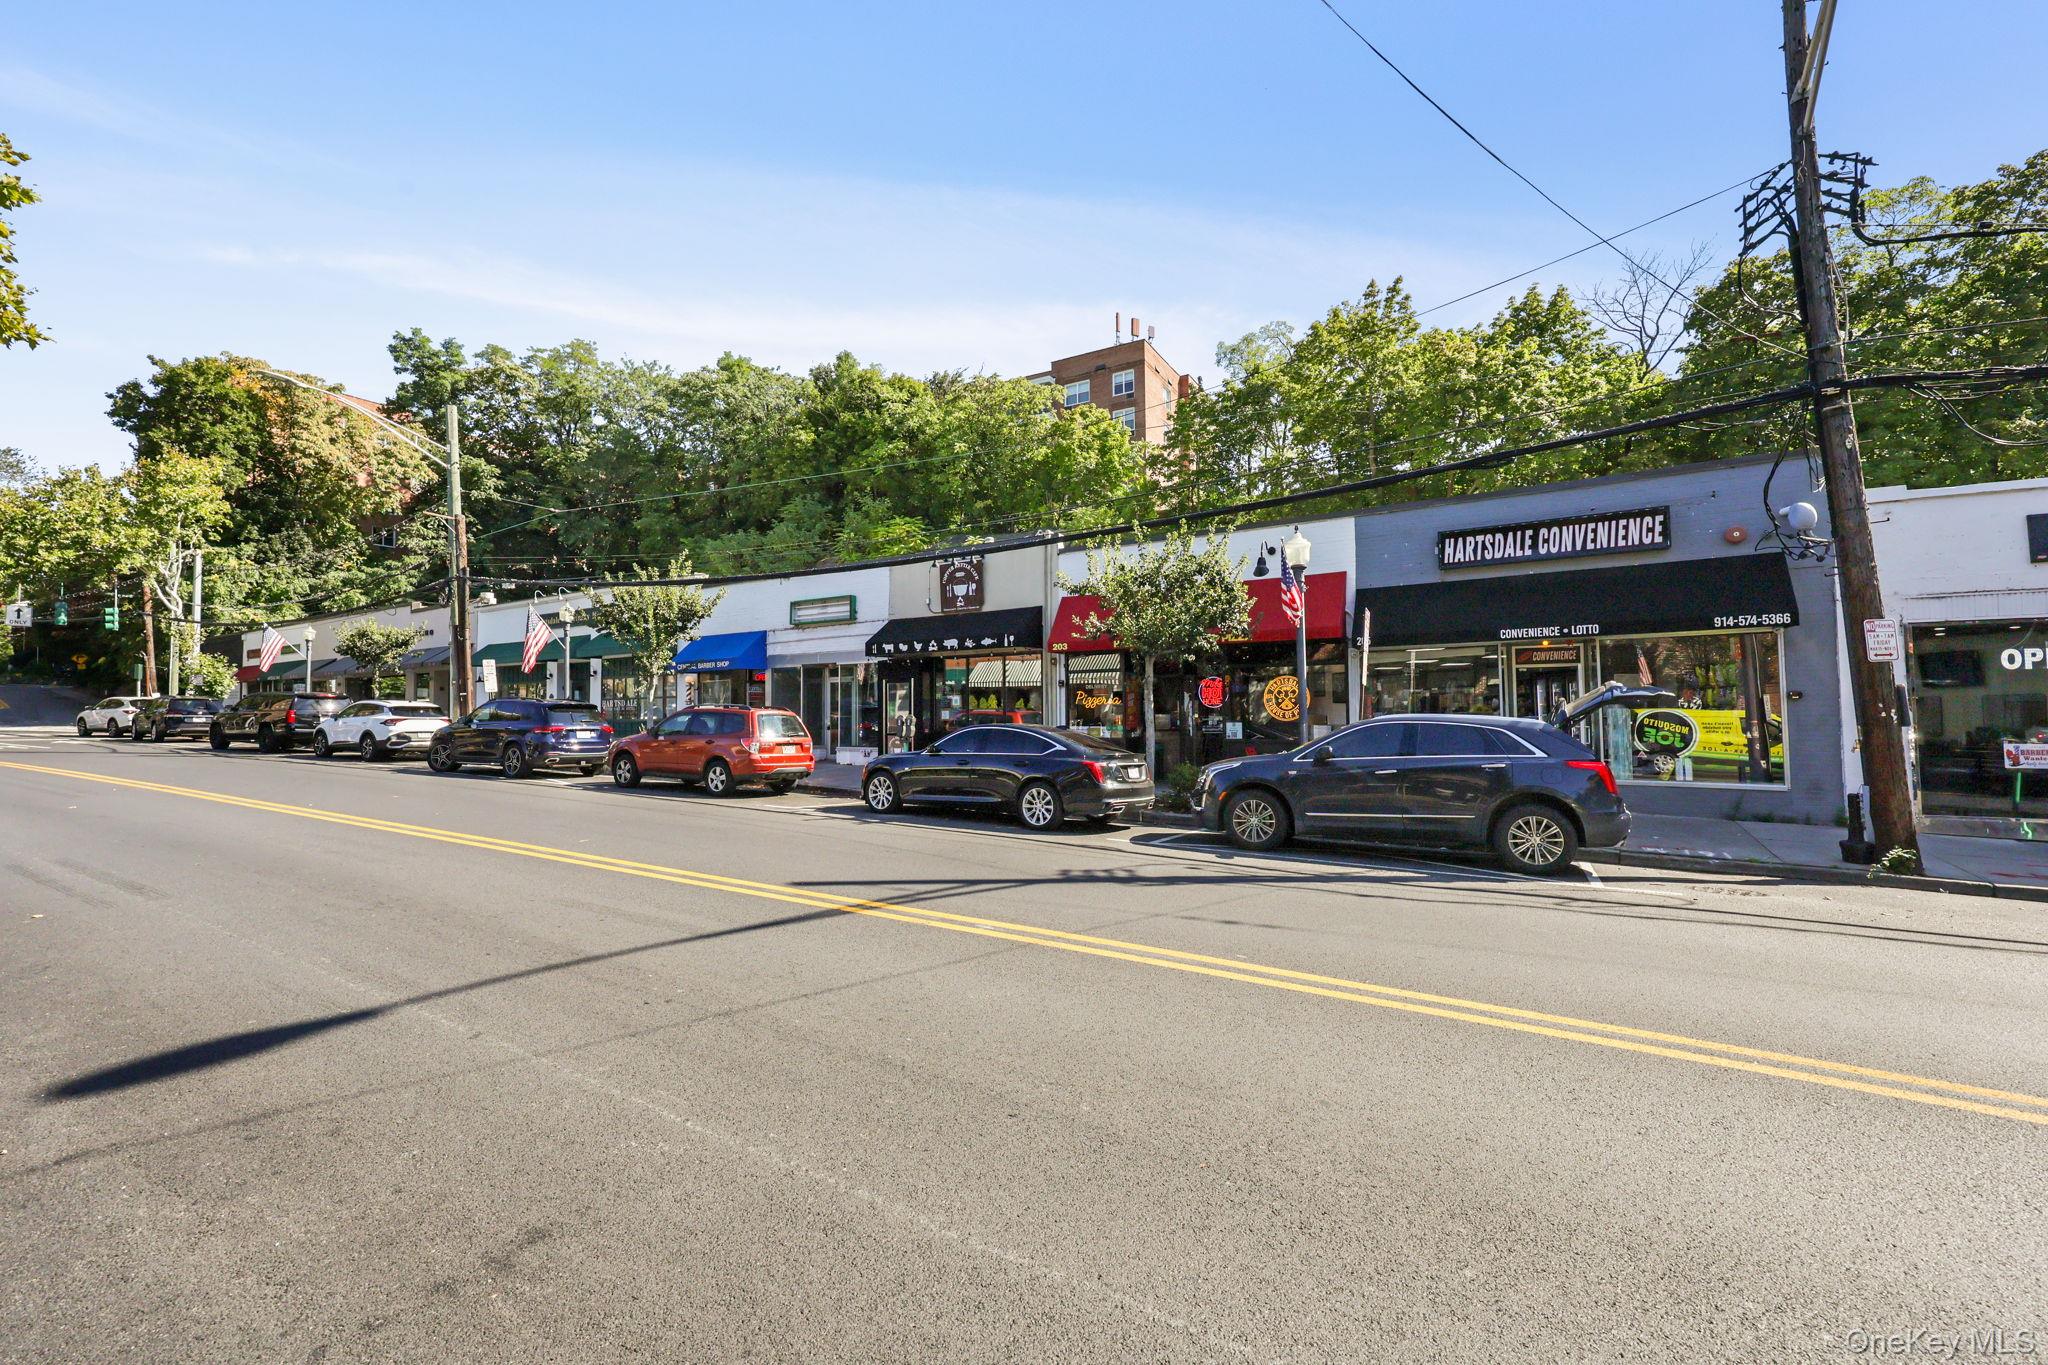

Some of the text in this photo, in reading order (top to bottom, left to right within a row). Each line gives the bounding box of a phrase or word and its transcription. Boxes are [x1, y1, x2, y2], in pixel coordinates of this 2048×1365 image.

[1444, 514, 1664, 563] HARTSDALE CONVENIENCE
[1714, 613, 1791, 627] 914-574-5366
[1865, 622, 1875, 631] NO
[1500, 624, 1599, 639] CONVENIENCE LOTTO
[1052, 643, 1068, 651] 203
[1532, 650, 1577, 661] CONVENIENCE
[2000, 647, 2048, 670] OP
[697, 661, 716, 669] BARBER
[716, 660, 730, 668] SHOP
[1270, 678, 1299, 691] HARTSDAL
